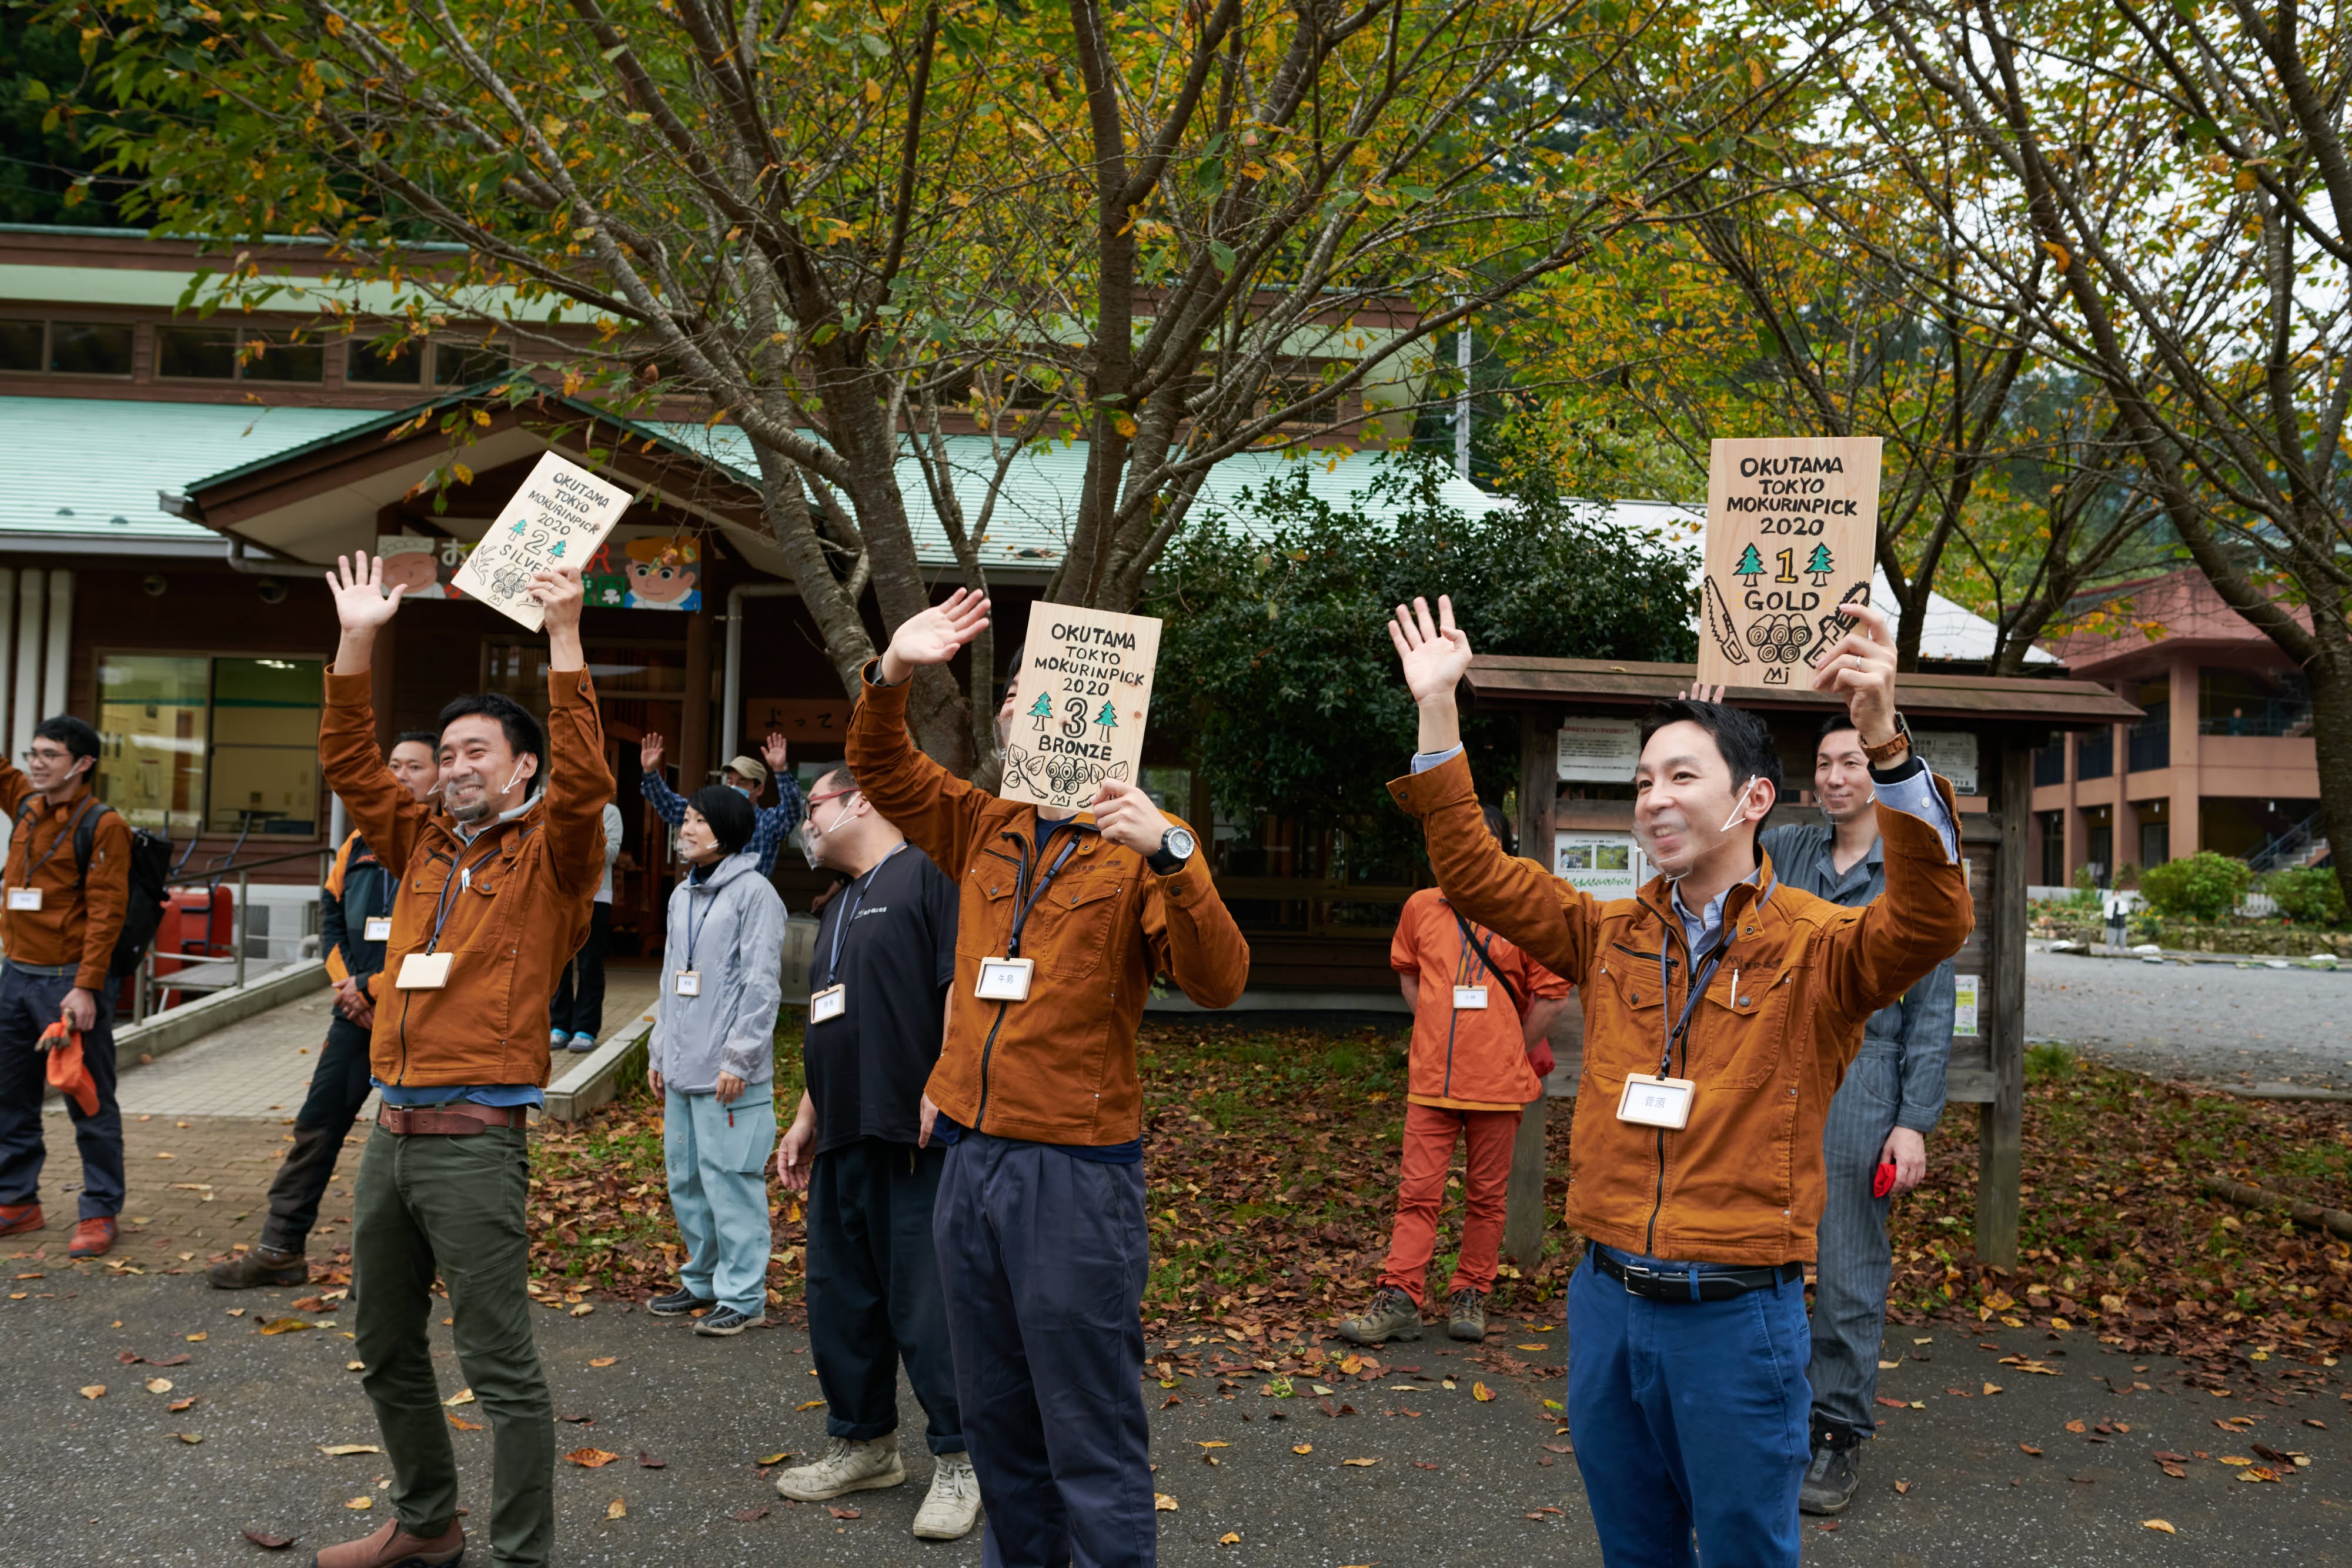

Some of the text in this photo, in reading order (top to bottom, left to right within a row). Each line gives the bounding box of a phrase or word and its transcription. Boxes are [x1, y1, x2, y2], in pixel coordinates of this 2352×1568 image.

[1740, 456, 1843, 477] OKUTAMA
[553, 473, 609, 508] OKUTAMA
[1759, 477, 1825, 494] TOKYO
[528, 490, 600, 535] MOKURINPICK
[554, 489, 589, 513] TOKYO
[1726, 497, 1857, 516] MOKURINPICK
[537, 512, 570, 535] 2020
[1760, 517, 1825, 536] 2020
[524, 529, 549, 556] 2
[1775, 547, 1798, 584] 1
[1745, 590, 1820, 611] GOLD
[1051, 623, 1135, 650] OKUTAMA
[1065, 646, 1120, 665] TOKYO
[1034, 657, 1144, 686] MOKURINPICK
[1063, 677, 1109, 696] 2020
[1063, 697, 1088, 738] 3
[1038, 735, 1112, 761] BRONZE
[1645, 1096, 1666, 1108] 菅原
